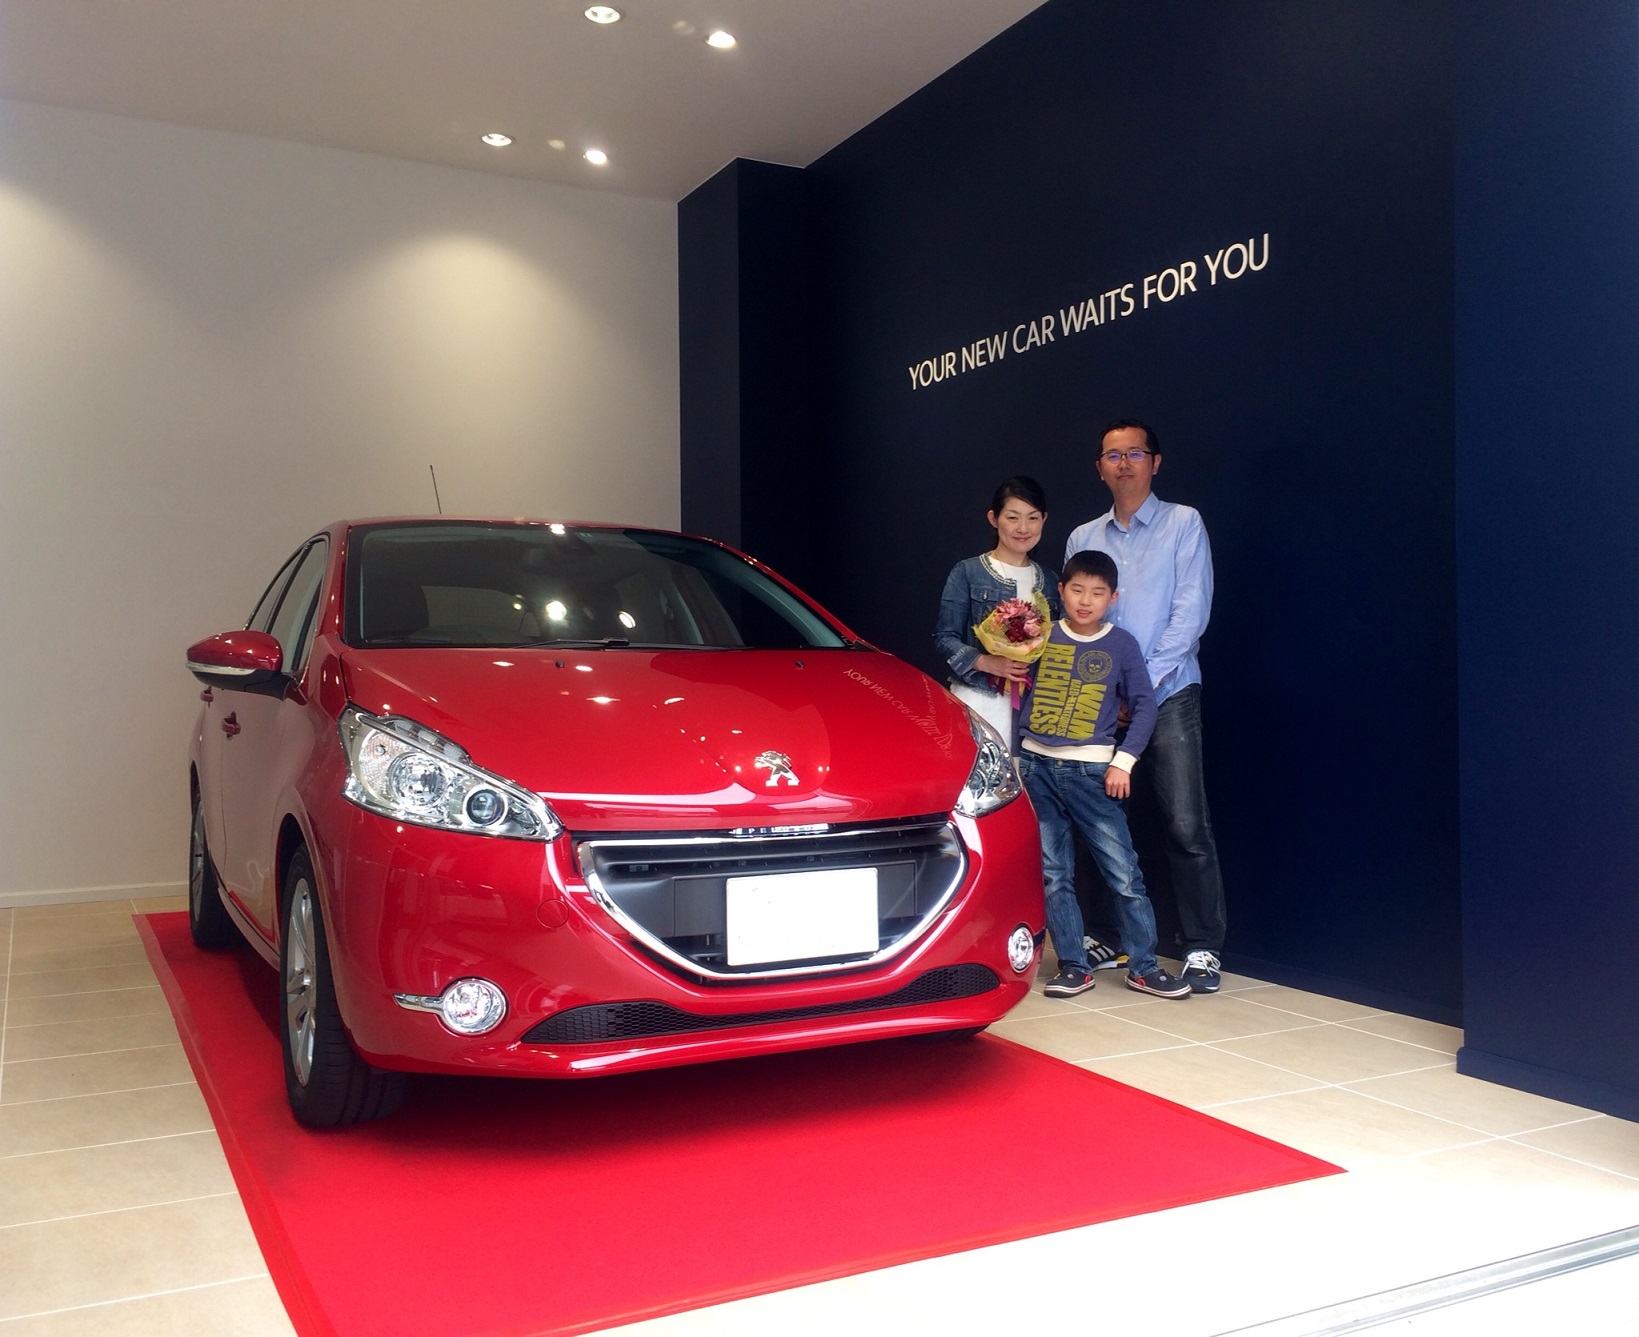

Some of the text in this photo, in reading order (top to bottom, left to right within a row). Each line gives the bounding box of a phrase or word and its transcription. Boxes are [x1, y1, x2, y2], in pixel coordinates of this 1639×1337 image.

[909, 233, 1270, 390] YOUR NEW CAR WAITS FOR YOU
[1030, 642, 1076, 735] RELENTLESS
[1067, 683, 1107, 740] WAM
